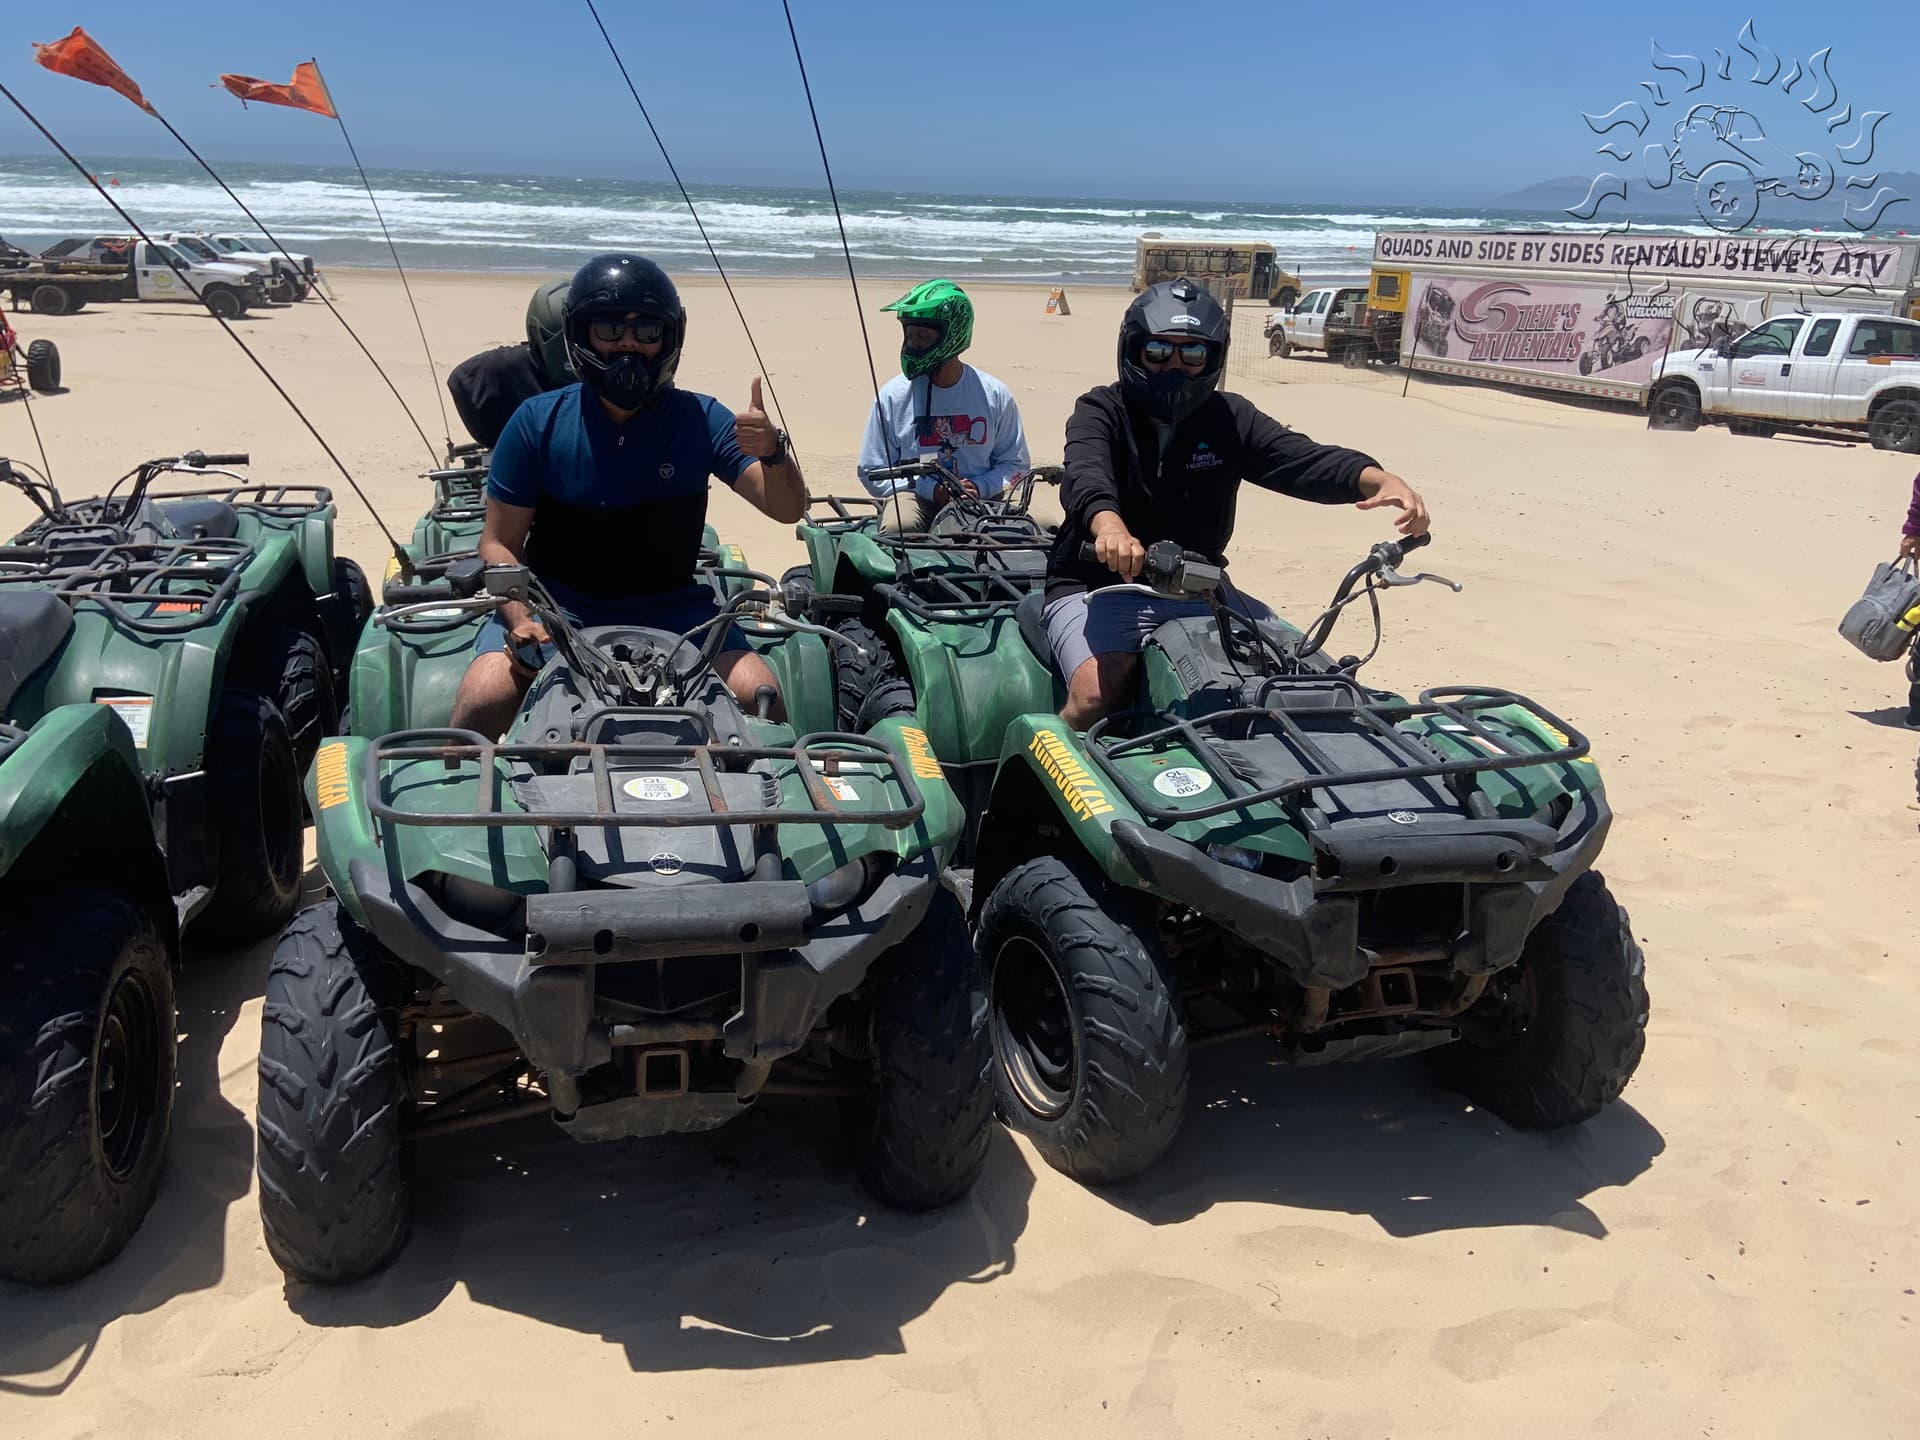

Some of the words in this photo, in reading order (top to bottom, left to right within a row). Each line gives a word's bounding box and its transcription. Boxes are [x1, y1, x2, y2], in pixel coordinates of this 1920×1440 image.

[1381, 237, 1433, 257] QUADS
[1436, 239, 1474, 259] AND
[1478, 241, 1517, 261] SIDE
[1521, 242, 1547, 263] BY
[1549, 242, 1605, 265] SIDES
[1611, 243, 1708, 270] RENTALS
[1830, 251, 1893, 279] ATV
[1625, 306, 1674, 319] WELCOME
[1469, 331, 1507, 360] ATV
[1503, 331, 1586, 361] RENTALS
[644, 791, 673, 799] 073
[1176, 783, 1201, 795] 063
